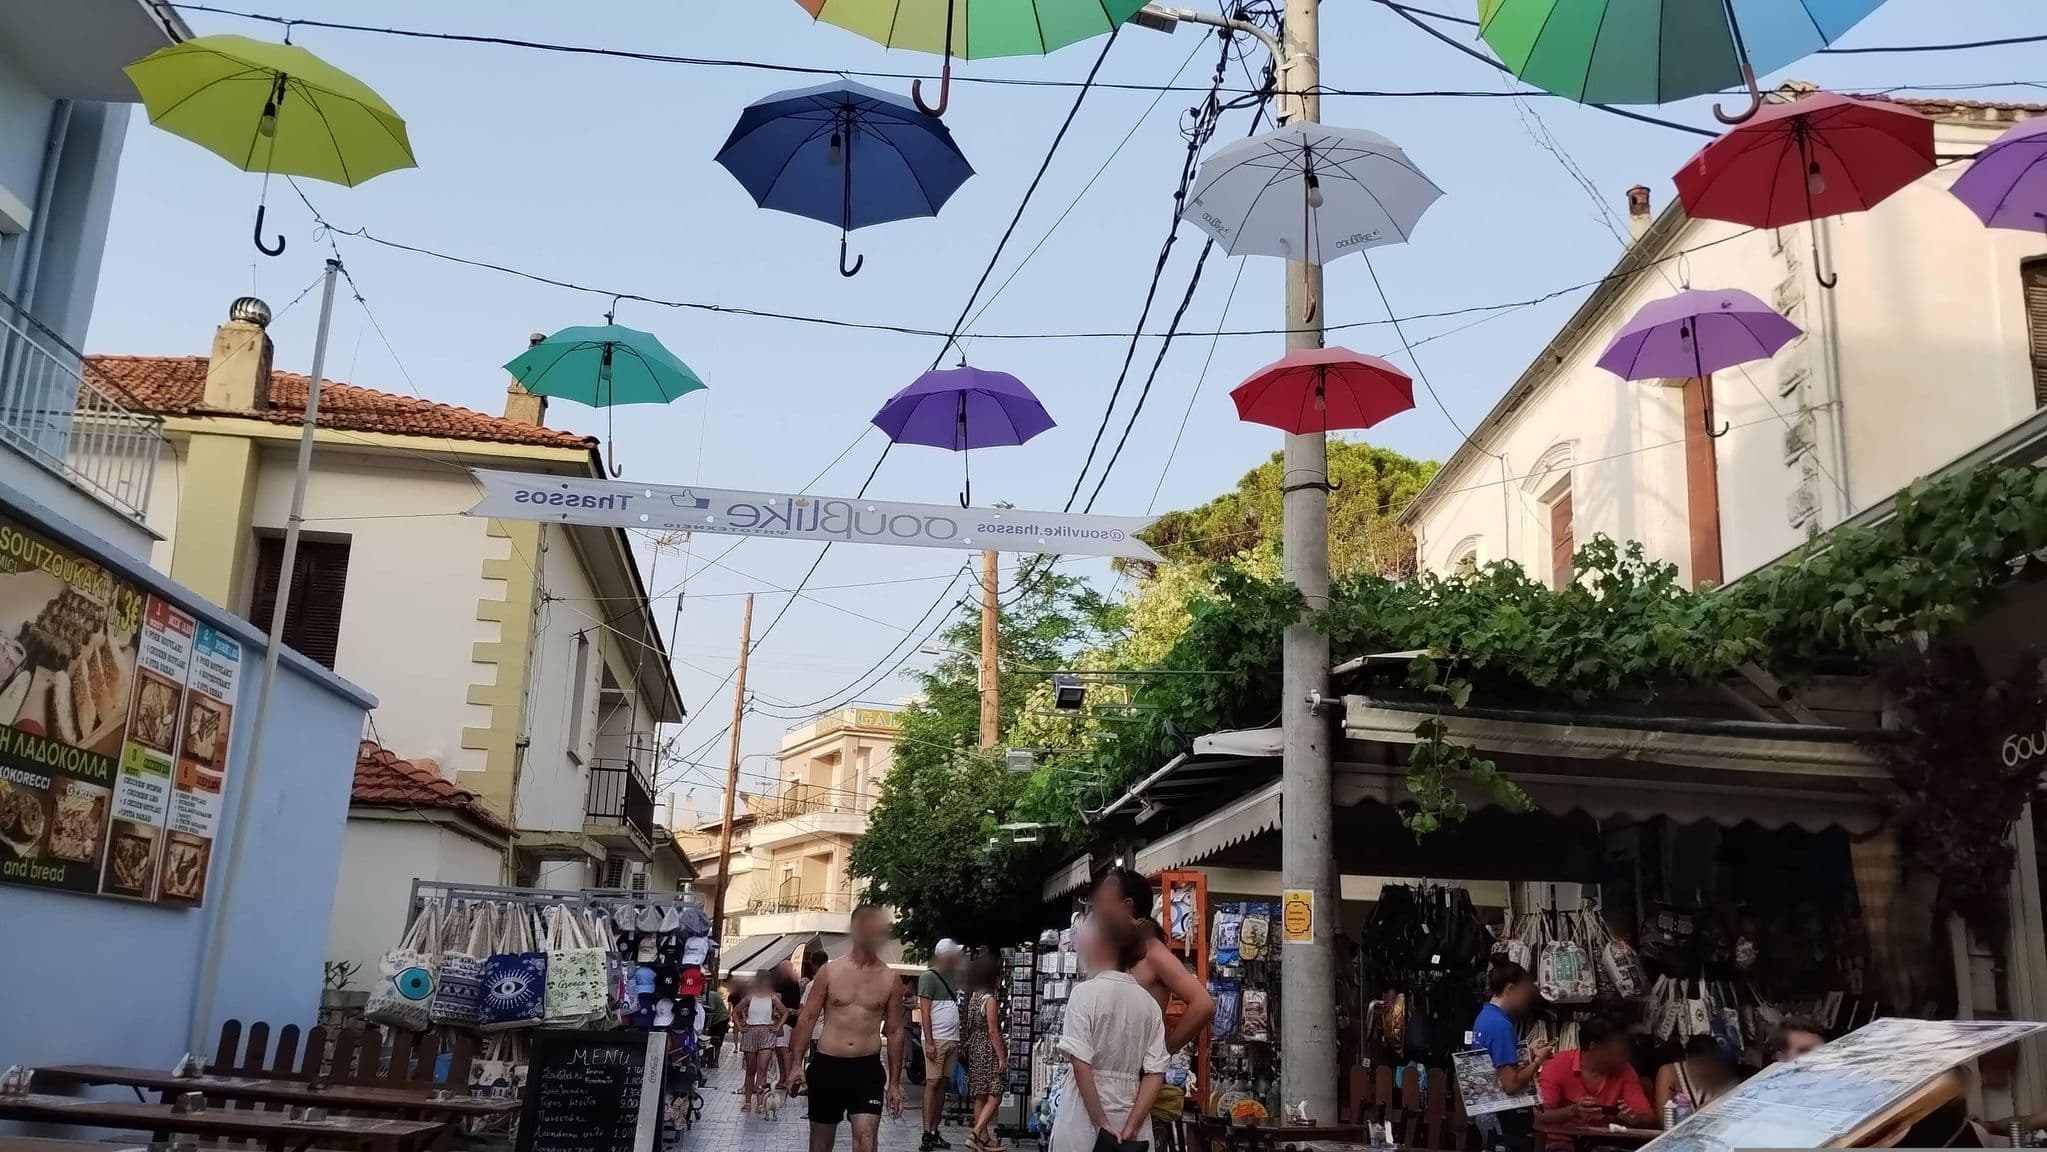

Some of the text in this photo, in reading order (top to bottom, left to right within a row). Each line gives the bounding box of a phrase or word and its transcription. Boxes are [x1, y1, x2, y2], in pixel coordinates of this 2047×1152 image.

[0, 526, 108, 602] SOUTZOUKAKI
[0, 727, 108, 779] Η ΛΑΔΟΚΟΛΛΑ
[66, 782, 97, 801] GYROS
[3, 859, 66, 882] and bread
[567, 1048, 630, 1065] MENU
